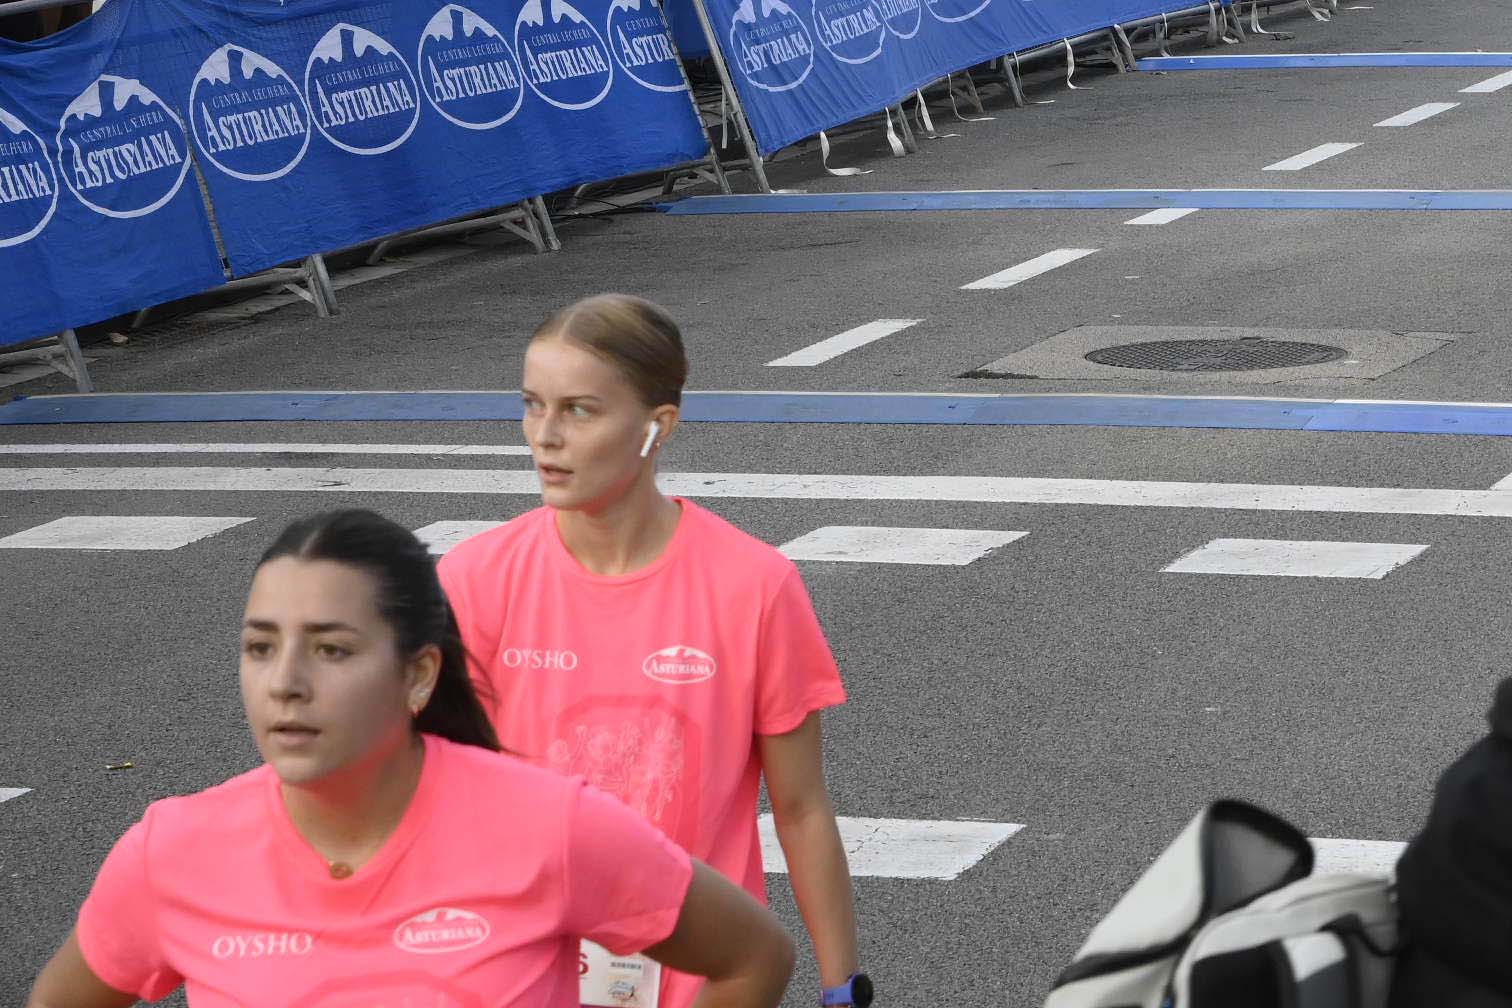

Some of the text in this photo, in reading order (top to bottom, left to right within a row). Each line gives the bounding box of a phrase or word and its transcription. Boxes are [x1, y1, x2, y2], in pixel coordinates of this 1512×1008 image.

[428, 55, 520, 104] ASTURIANA
[522, 39, 609, 84] ASTURIANA
[213, 83, 290, 110] CENTRAL LECHERA
[315, 76, 415, 130] ASTURIANA
[202, 101, 306, 154] ASTURIANA
[69, 130, 182, 191] ASTURIANA
[503, 647, 578, 671] OYSHO
[649, 658, 711, 677] ASTURIANA
[212, 931, 314, 959] OYSHO
